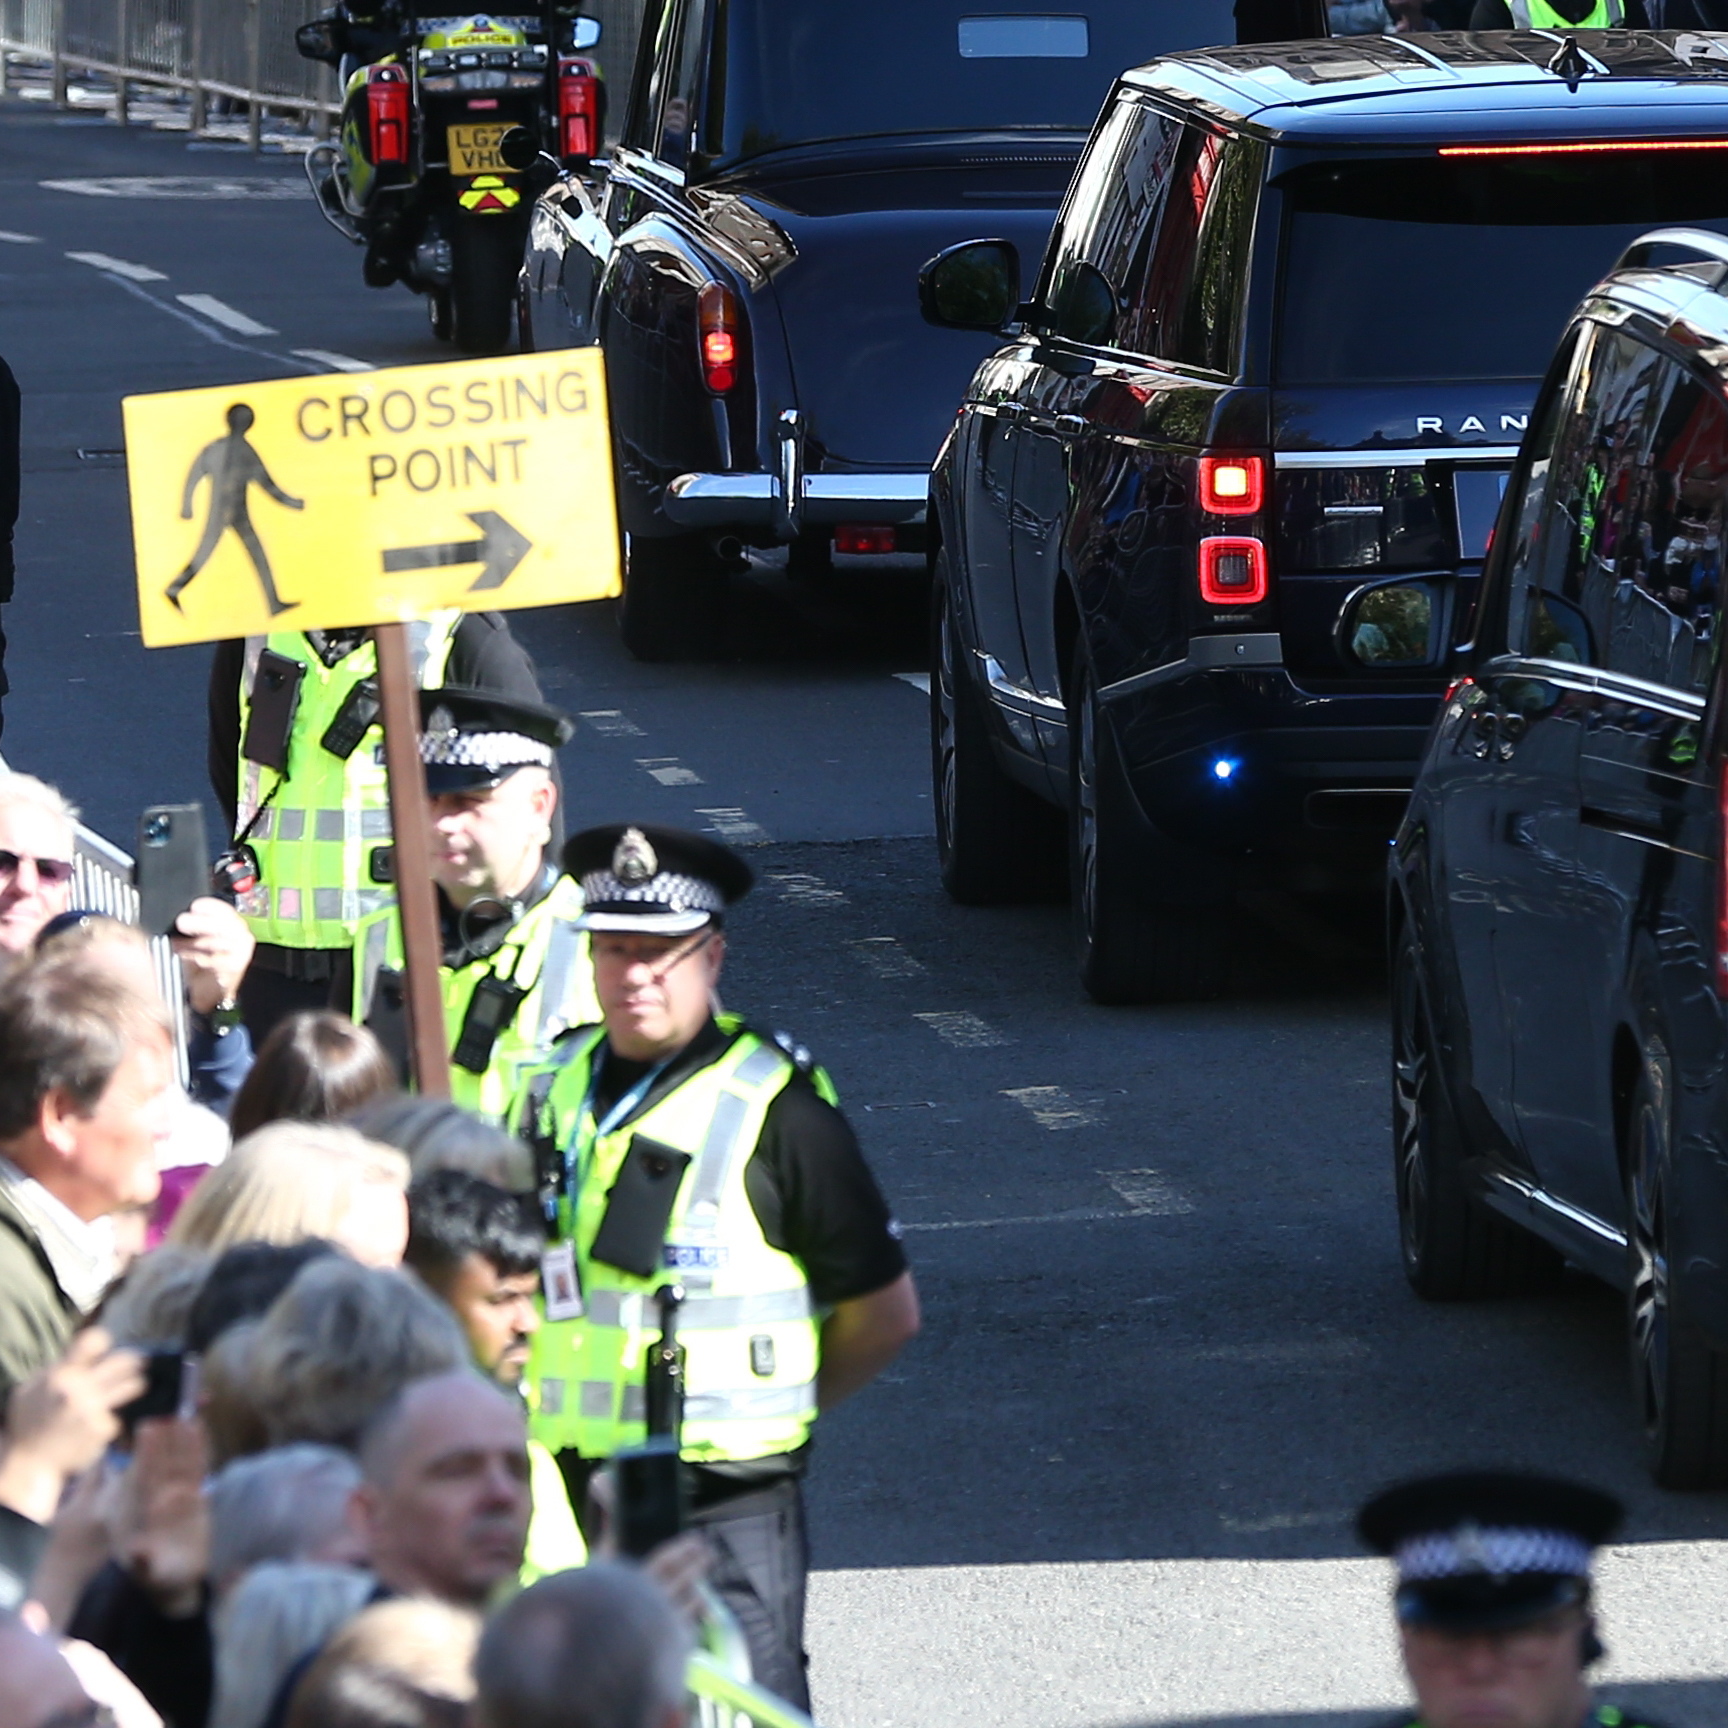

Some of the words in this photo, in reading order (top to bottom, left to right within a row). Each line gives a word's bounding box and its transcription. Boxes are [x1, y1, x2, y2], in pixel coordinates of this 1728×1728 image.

[451, 34, 512, 46] POLICE
[456, 126, 507, 149] LG2
[296, 371, 589, 443] CROSSING
[1416, 414, 1529, 434] RAN
[368, 439, 528, 497] POINT
